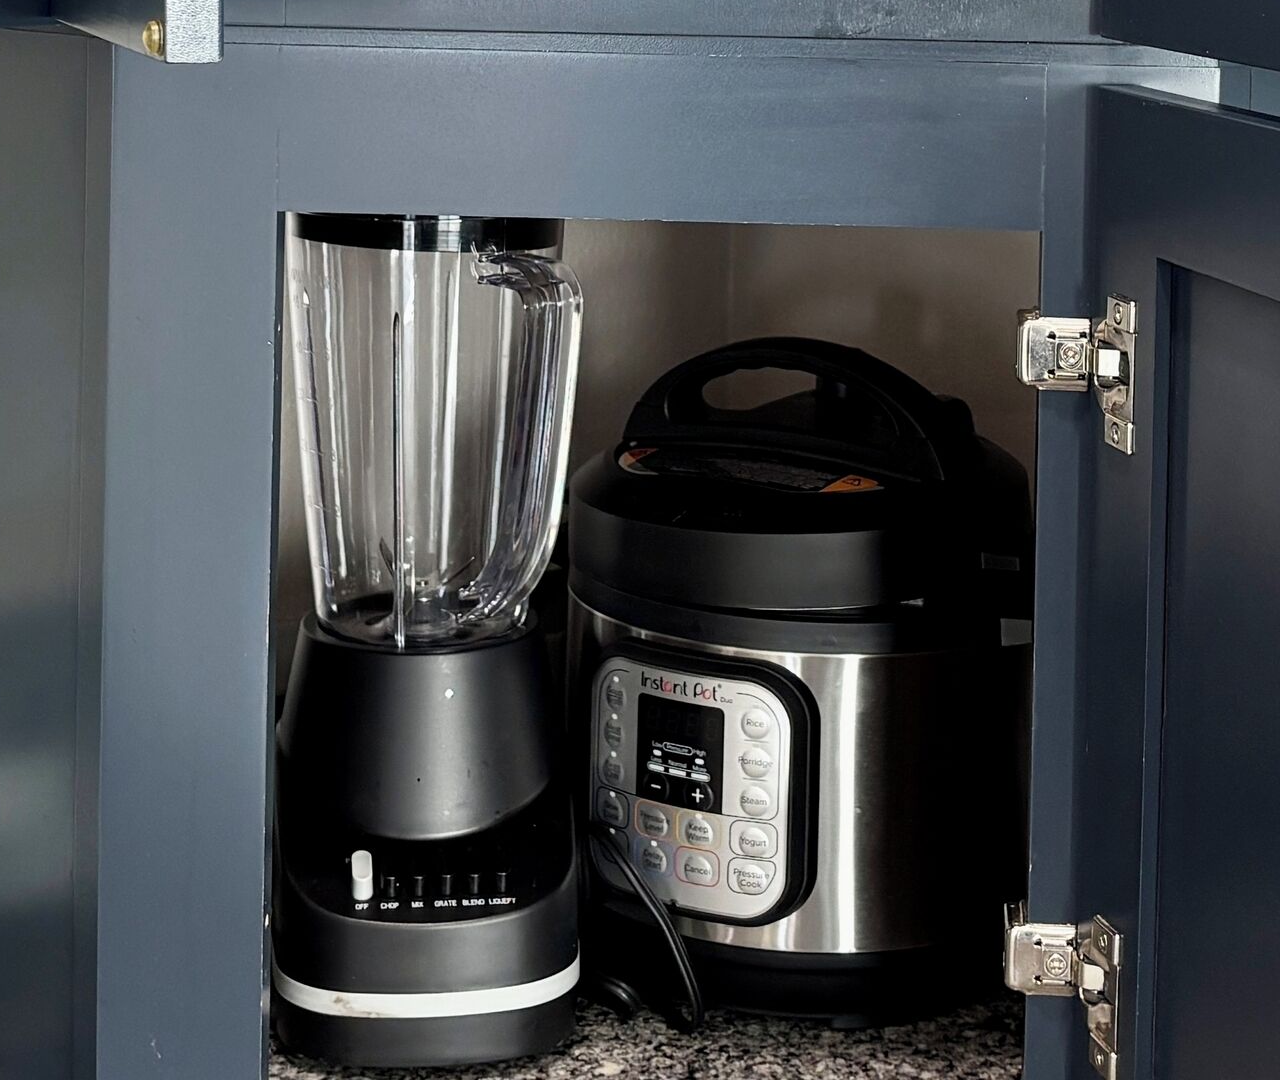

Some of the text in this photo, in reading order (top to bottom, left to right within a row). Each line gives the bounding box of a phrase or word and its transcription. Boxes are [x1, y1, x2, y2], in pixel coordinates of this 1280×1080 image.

[641, 671, 688, 697] Instant
[693, 682, 718, 701] Pot
[745, 719, 765, 729] Rice
[738, 756, 773, 768] Porridge
[741, 795, 767, 806] Steam
[688, 821, 709, 834] Keep
[740, 835, 767, 848] Yogurt
[684, 863, 711, 876] Cancel
[733, 867, 770, 879] Pressure
[740, 879, 763, 889] Cook
